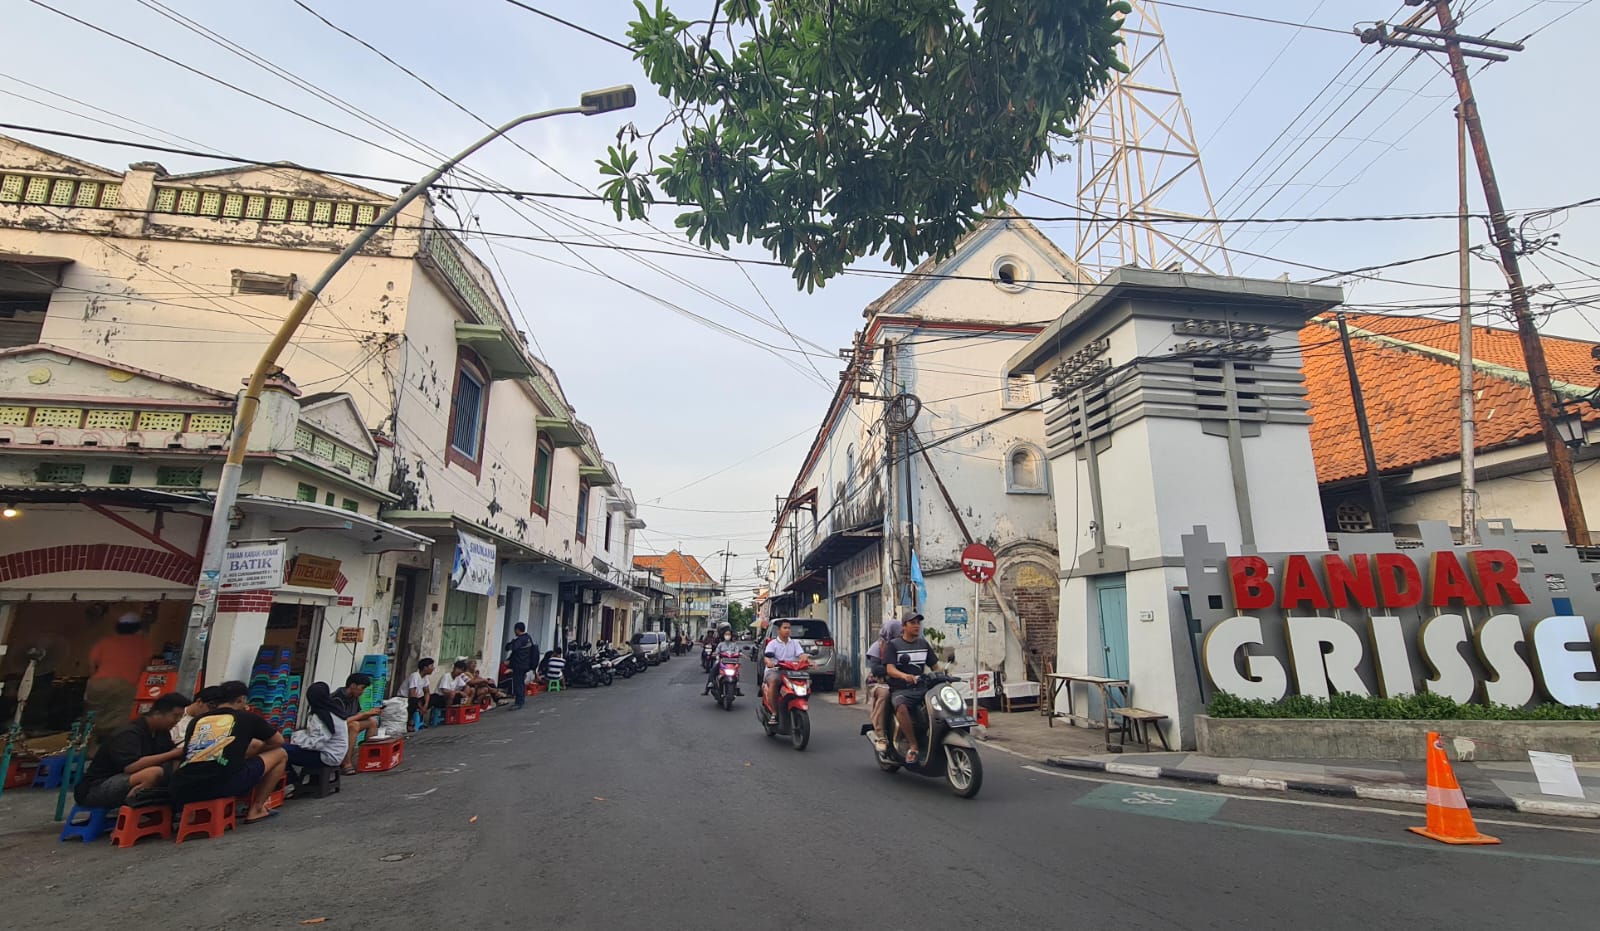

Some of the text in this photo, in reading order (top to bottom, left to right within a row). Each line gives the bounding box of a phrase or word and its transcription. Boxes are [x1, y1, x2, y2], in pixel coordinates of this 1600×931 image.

[230, 558, 272, 571] BATIK
[1228, 549, 1532, 609] BANDAR
[1203, 614, 1600, 709] GRISSE
